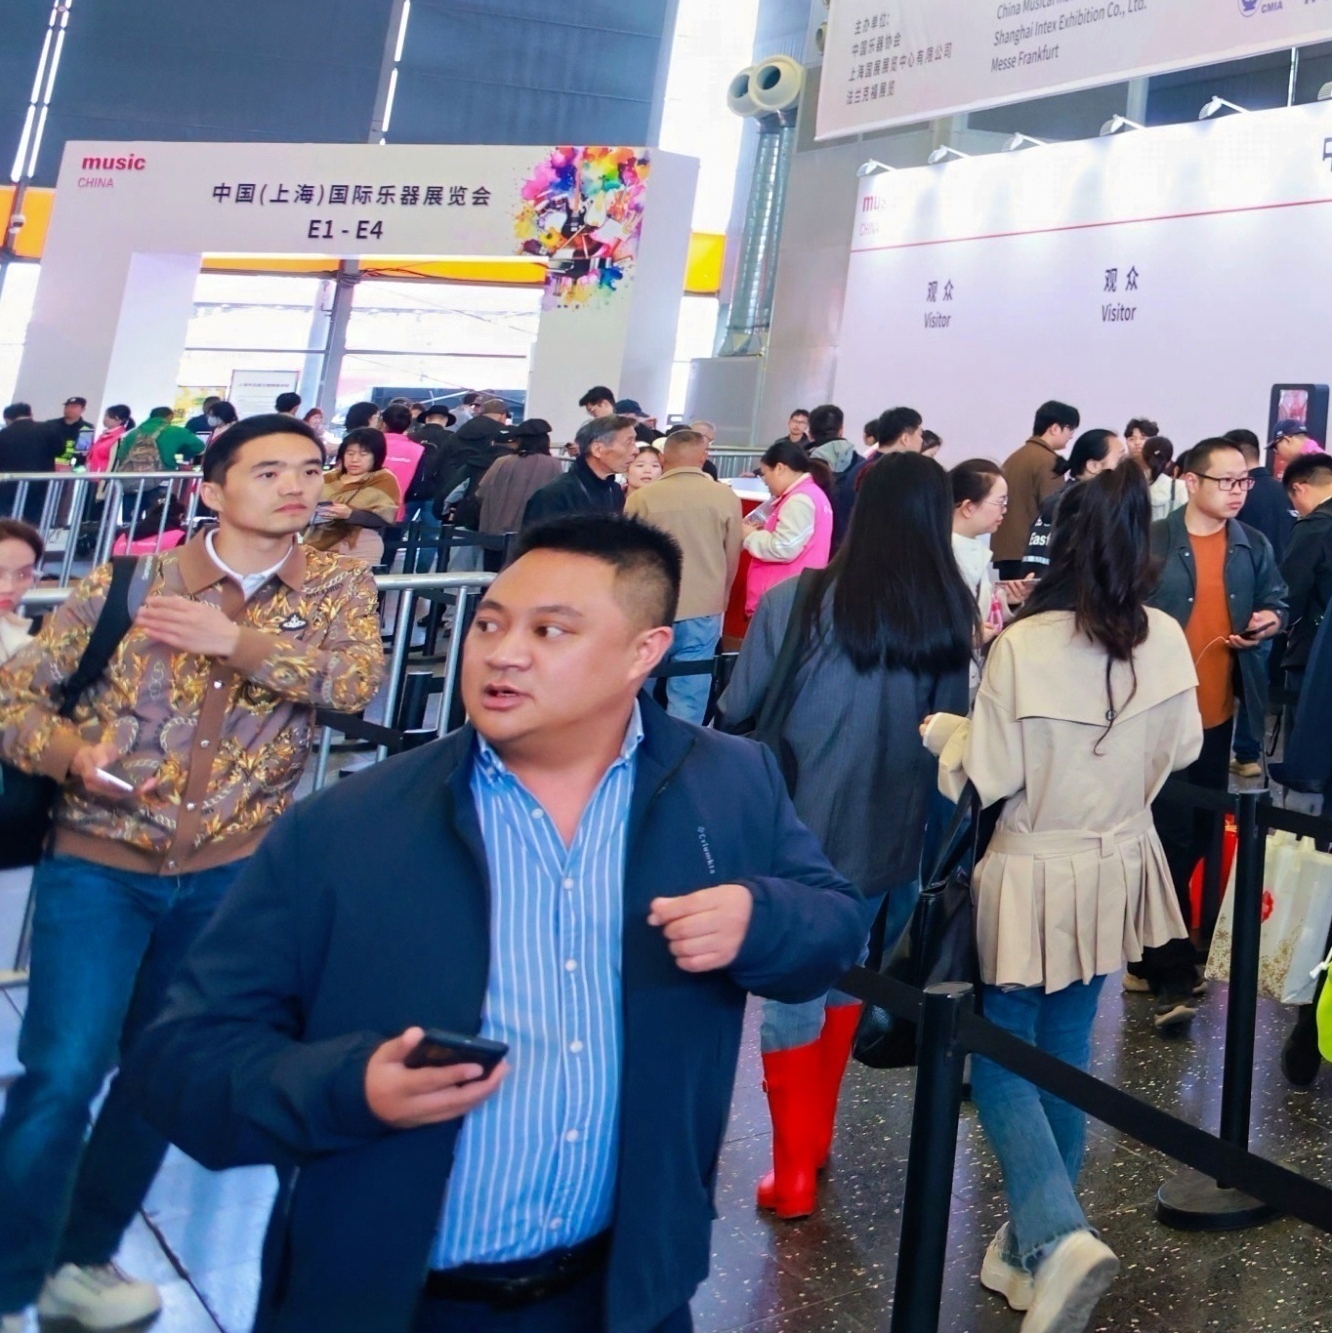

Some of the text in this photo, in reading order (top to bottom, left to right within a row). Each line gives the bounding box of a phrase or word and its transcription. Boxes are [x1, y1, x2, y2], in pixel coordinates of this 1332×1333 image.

[997, 3, 1021, 19] China
[1261, 0, 1283, 14] CMIA
[994, 22, 1033, 46] Shanghai
[1035, 19, 1058, 36] Intex
[1058, 6, 1105, 31] Exhibition
[990, 44, 1059, 72] Messe Frankfurt
[81, 153, 146, 172] music
[77, 176, 114, 189] CHINA
[211, 182, 492, 208] 中国(上海)国际乐器展览会
[308, 219, 334, 239] E1
[355, 219, 384, 241] E4
[1103, 266, 1139, 293] 观众
[926, 279, 954, 303] 观众
[923, 311, 951, 330] Visitor
[1100, 303, 1137, 324] Visitor
